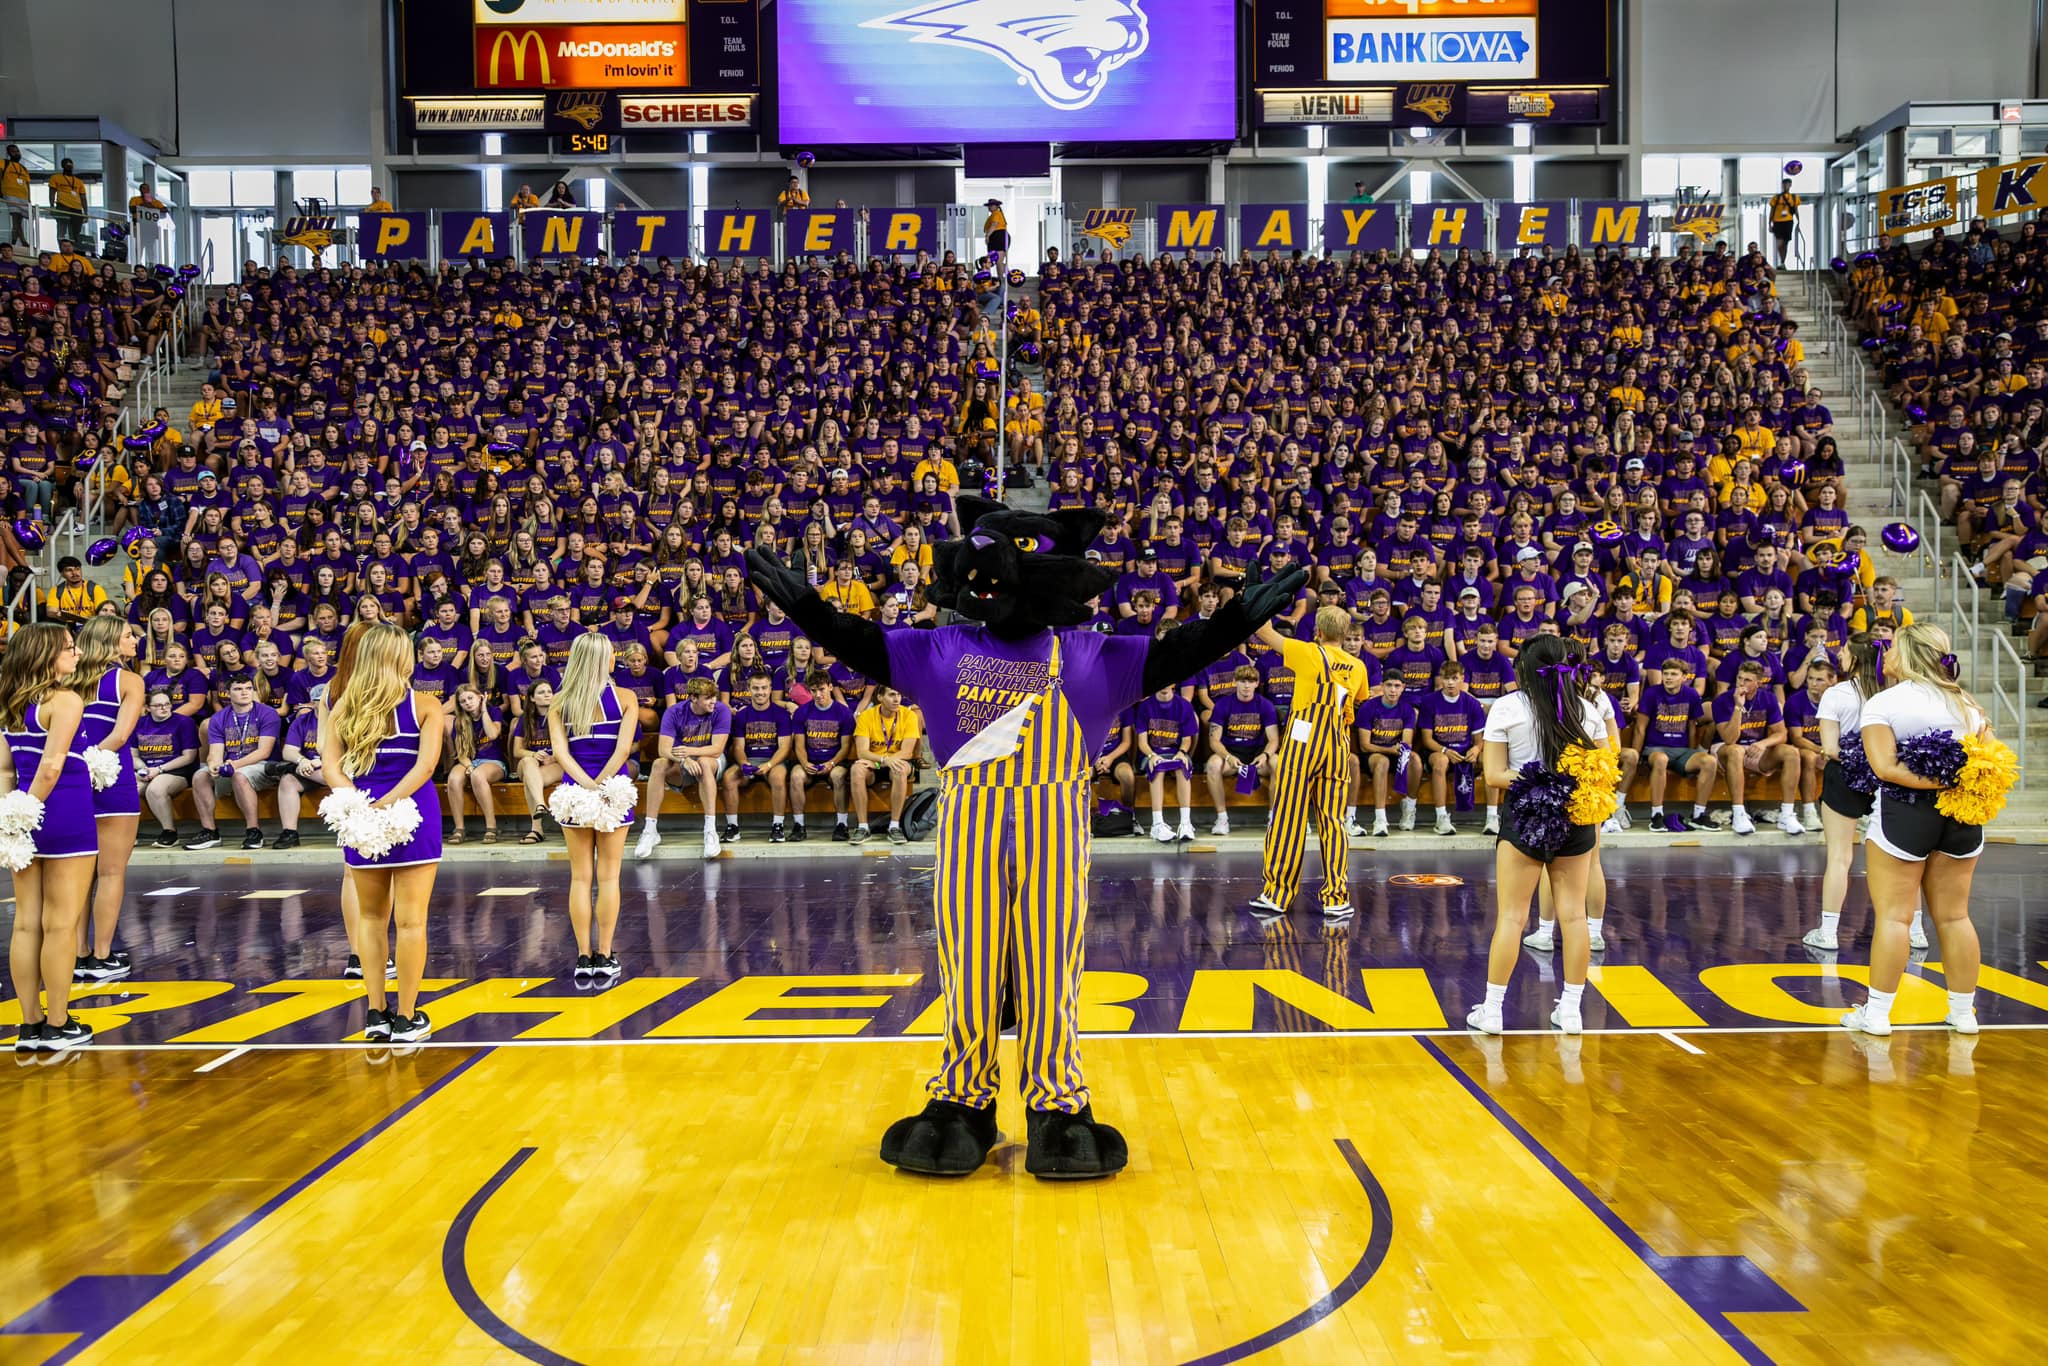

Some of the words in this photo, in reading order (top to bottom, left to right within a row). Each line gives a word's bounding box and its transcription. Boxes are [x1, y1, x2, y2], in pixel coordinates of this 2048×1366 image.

[723, 37, 743, 45] TEAM
[1267, 40, 1290, 48] FOULS
[1271, 32, 1290, 40] TEAM
[557, 40, 675, 57] McDonald's
[723, 43, 746, 52] FOULS
[1333, 32, 1427, 63] BANK
[1432, 32, 1518, 62] IOWA
[604, 64, 623, 77] i'm
[627, 64, 662, 77] lovin'
[664, 64, 673, 77] it
[719, 69, 744, 78] PERIOD
[1269, 64, 1295, 73] PERIOD
[1407, 84, 1456, 102] UNI
[623, 104, 747, 123] SCHEELS
[1301, 95, 1360, 115] VENU
[417, 108, 544, 123] WWW.UNIPANTHERS.COM
[571, 134, 608, 151] 5:40
[1993, 162, 2047, 211] K
[138, 209, 160, 222] 109
[947, 207, 967, 217] 110
[1084, 208, 1137, 230] UNI
[1674, 203, 1726, 226] UNI
[284, 216, 337, 238] UNI
[1332, 662, 1354, 672] UNI
[956, 685, 1037, 706] PANTH
[956, 716, 991, 734] PA
